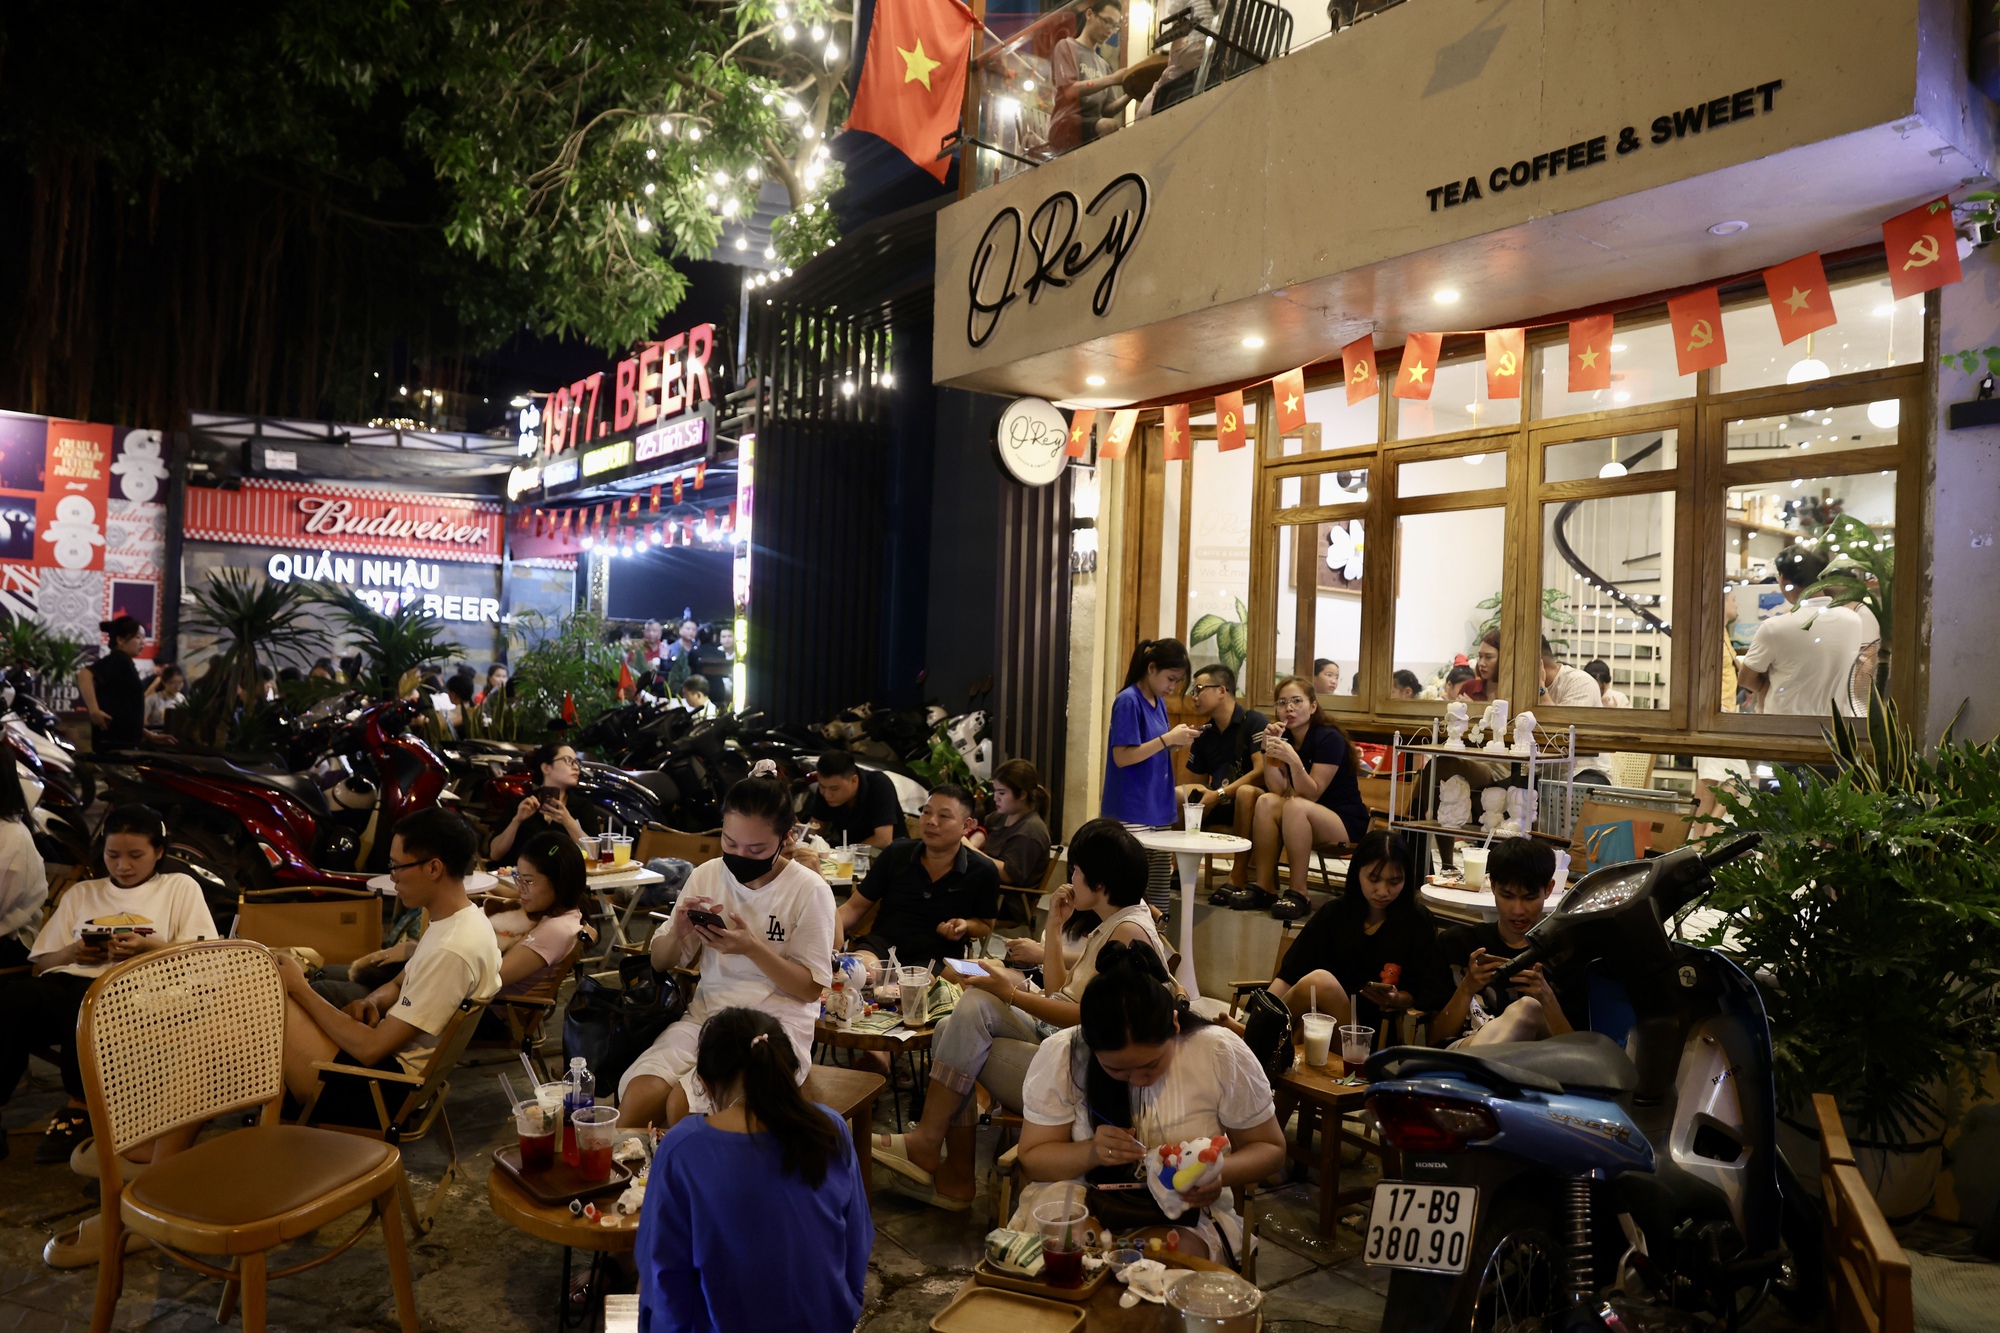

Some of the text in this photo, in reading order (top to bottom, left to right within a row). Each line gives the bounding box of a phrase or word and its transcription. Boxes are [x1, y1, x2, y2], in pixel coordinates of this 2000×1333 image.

[1426, 79, 1783, 212] TEA COFFEE & SWEET
[299, 497, 489, 544] Budweiser
[268, 550, 355, 583] QUÁN
[1071, 549, 1097, 573] 229
[766, 915, 785, 941] LA
[1389, 1188, 1460, 1224] 17-B9
[1368, 1225, 1465, 1266] 380.90
